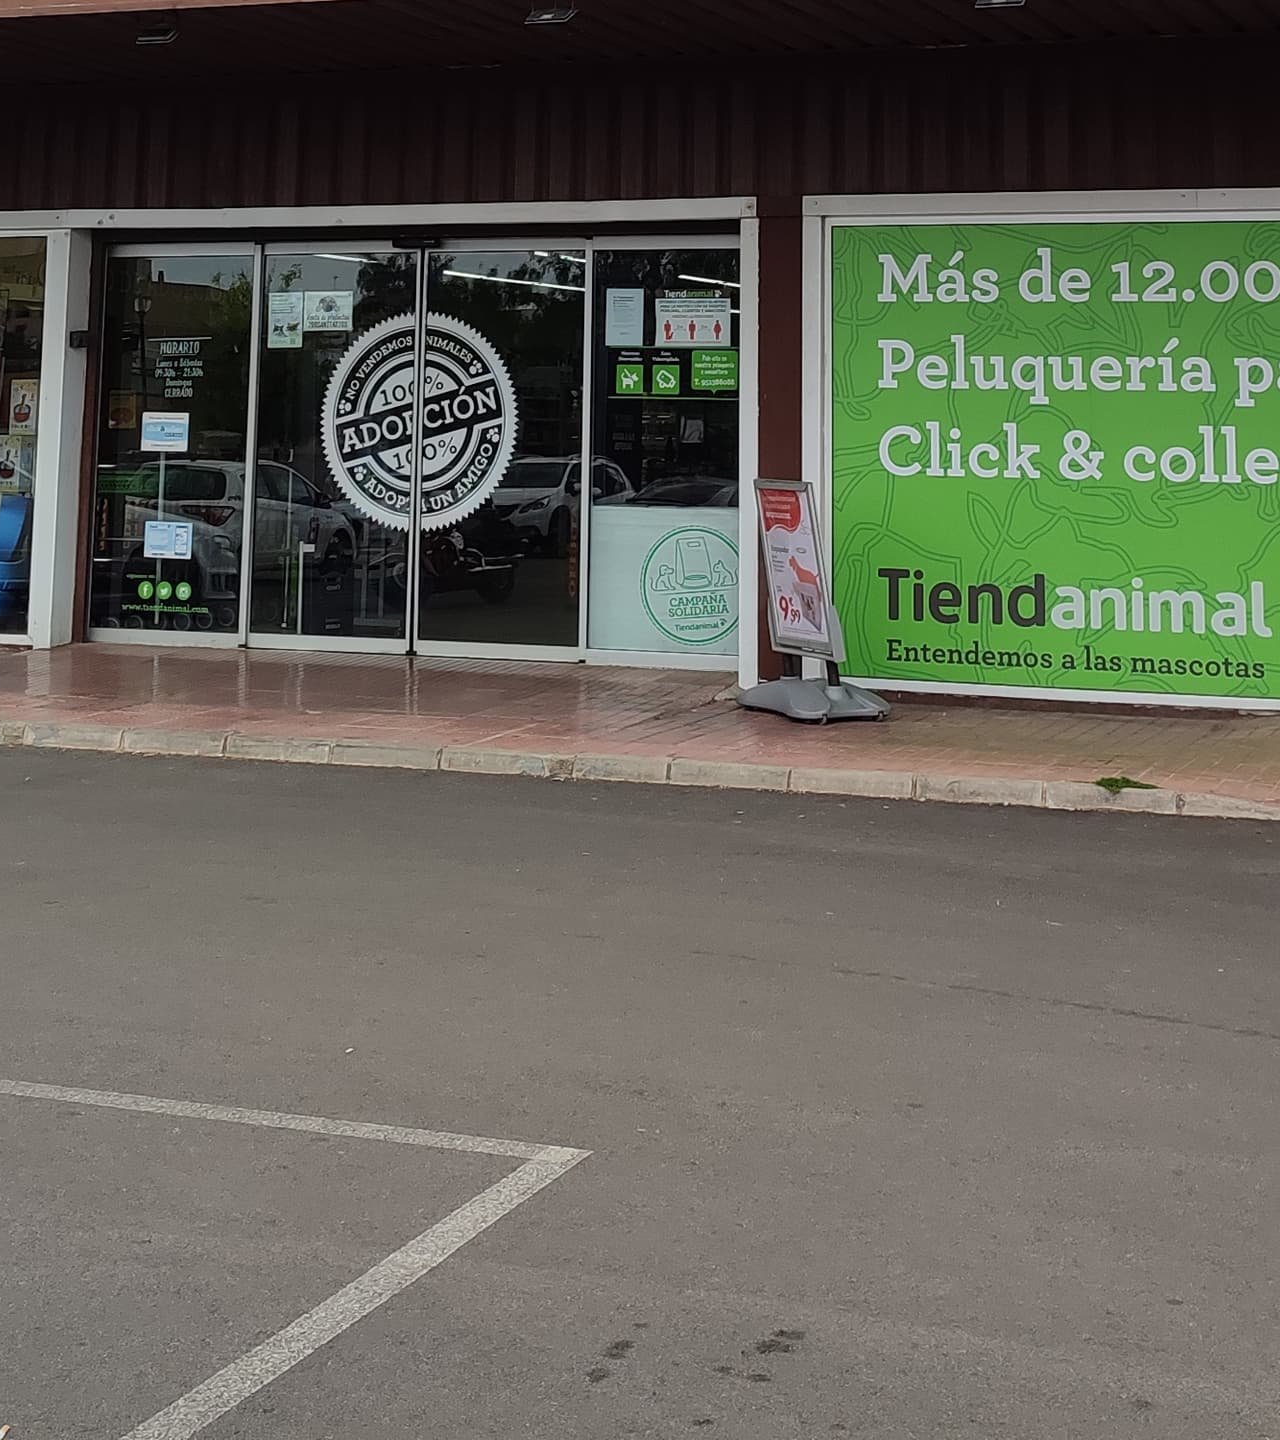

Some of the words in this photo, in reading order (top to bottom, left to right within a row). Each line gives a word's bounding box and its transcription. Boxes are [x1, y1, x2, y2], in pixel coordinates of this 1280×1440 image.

[877, 248, 1000, 304] Más
[1017, 247, 1091, 303] de
[160, 341, 200, 354] HORARIO
[345, 379, 360, 400] NO
[356, 336, 413, 379] VENDEMOS
[426, 335, 473, 364] NIMALES
[877, 336, 1217, 406] Peluquería
[364, 477, 427, 512] ADOP
[429, 490, 454, 510] UN
[455, 443, 494, 498] AMIGO
[878, 420, 1040, 480] Click
[1058, 428, 1104, 481] &
[668, 604, 729, 618] SOLIDARIA
[669, 591, 727, 608] CAMPAÑA
[877, 568, 1273, 637] Tiendanimal
[885, 639, 1053, 669] Entendemos
[1061, 653, 1077, 671] a
[1084, 645, 1122, 672] las
[1131, 654, 1266, 679] mascotas
